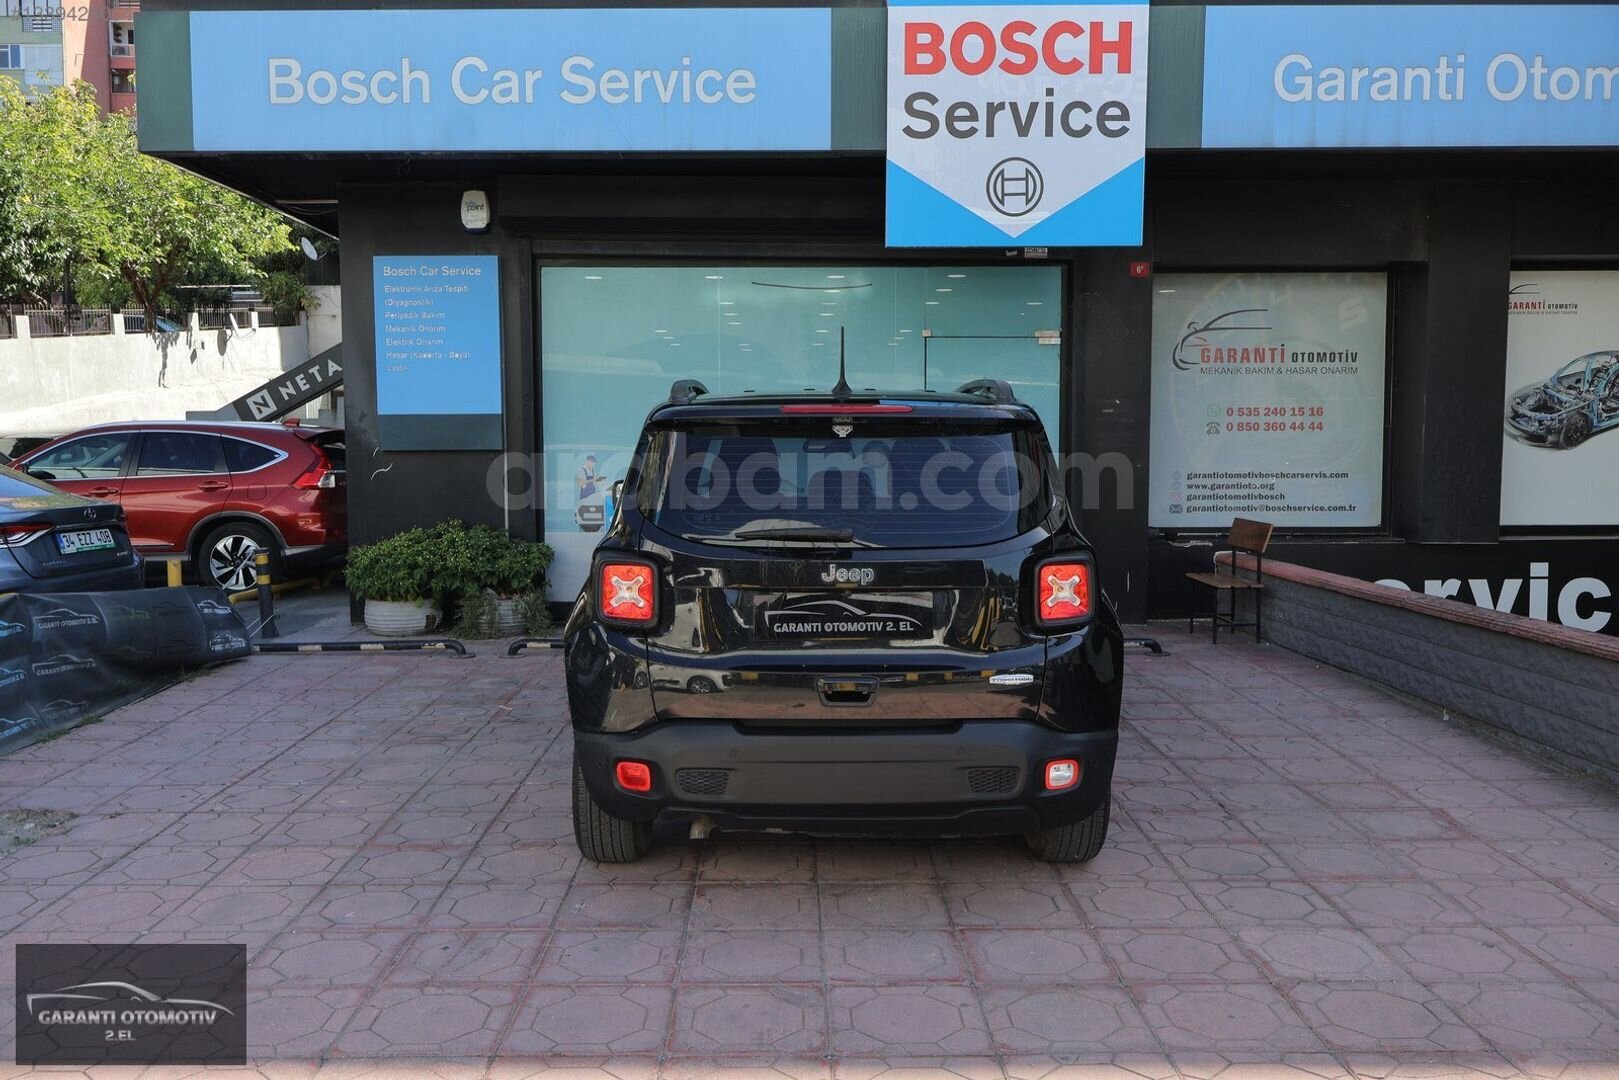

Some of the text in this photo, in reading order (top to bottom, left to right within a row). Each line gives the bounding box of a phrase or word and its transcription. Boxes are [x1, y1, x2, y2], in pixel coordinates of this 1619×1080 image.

[904, 20, 1133, 76] BOSCH
[268, 55, 757, 104] Bosch Car Service
[1273, 53, 1619, 102] Garanti Otom
[901, 87, 1131, 140] Service
[383, 265, 482, 277] Bosch Car Service
[1200, 344, 1358, 364] GARANTİ OTOMOTİV
[1276, 366, 1283, 375] &
[1285, 366, 1318, 375] HASAR
[278, 359, 344, 401] NETA
[1226, 407, 1324, 417] 0 535 240 15 16
[1226, 422, 1324, 432] 0 850 360 44 44
[1186, 493, 1285, 501] garantiotomotivbosch
[62, 534, 75, 548] 34
[77, 532, 95, 546] EZZ
[821, 564, 875, 585] Jeep
[773, 621, 914, 633] GARANTI OTOMOTIV 2. EL
